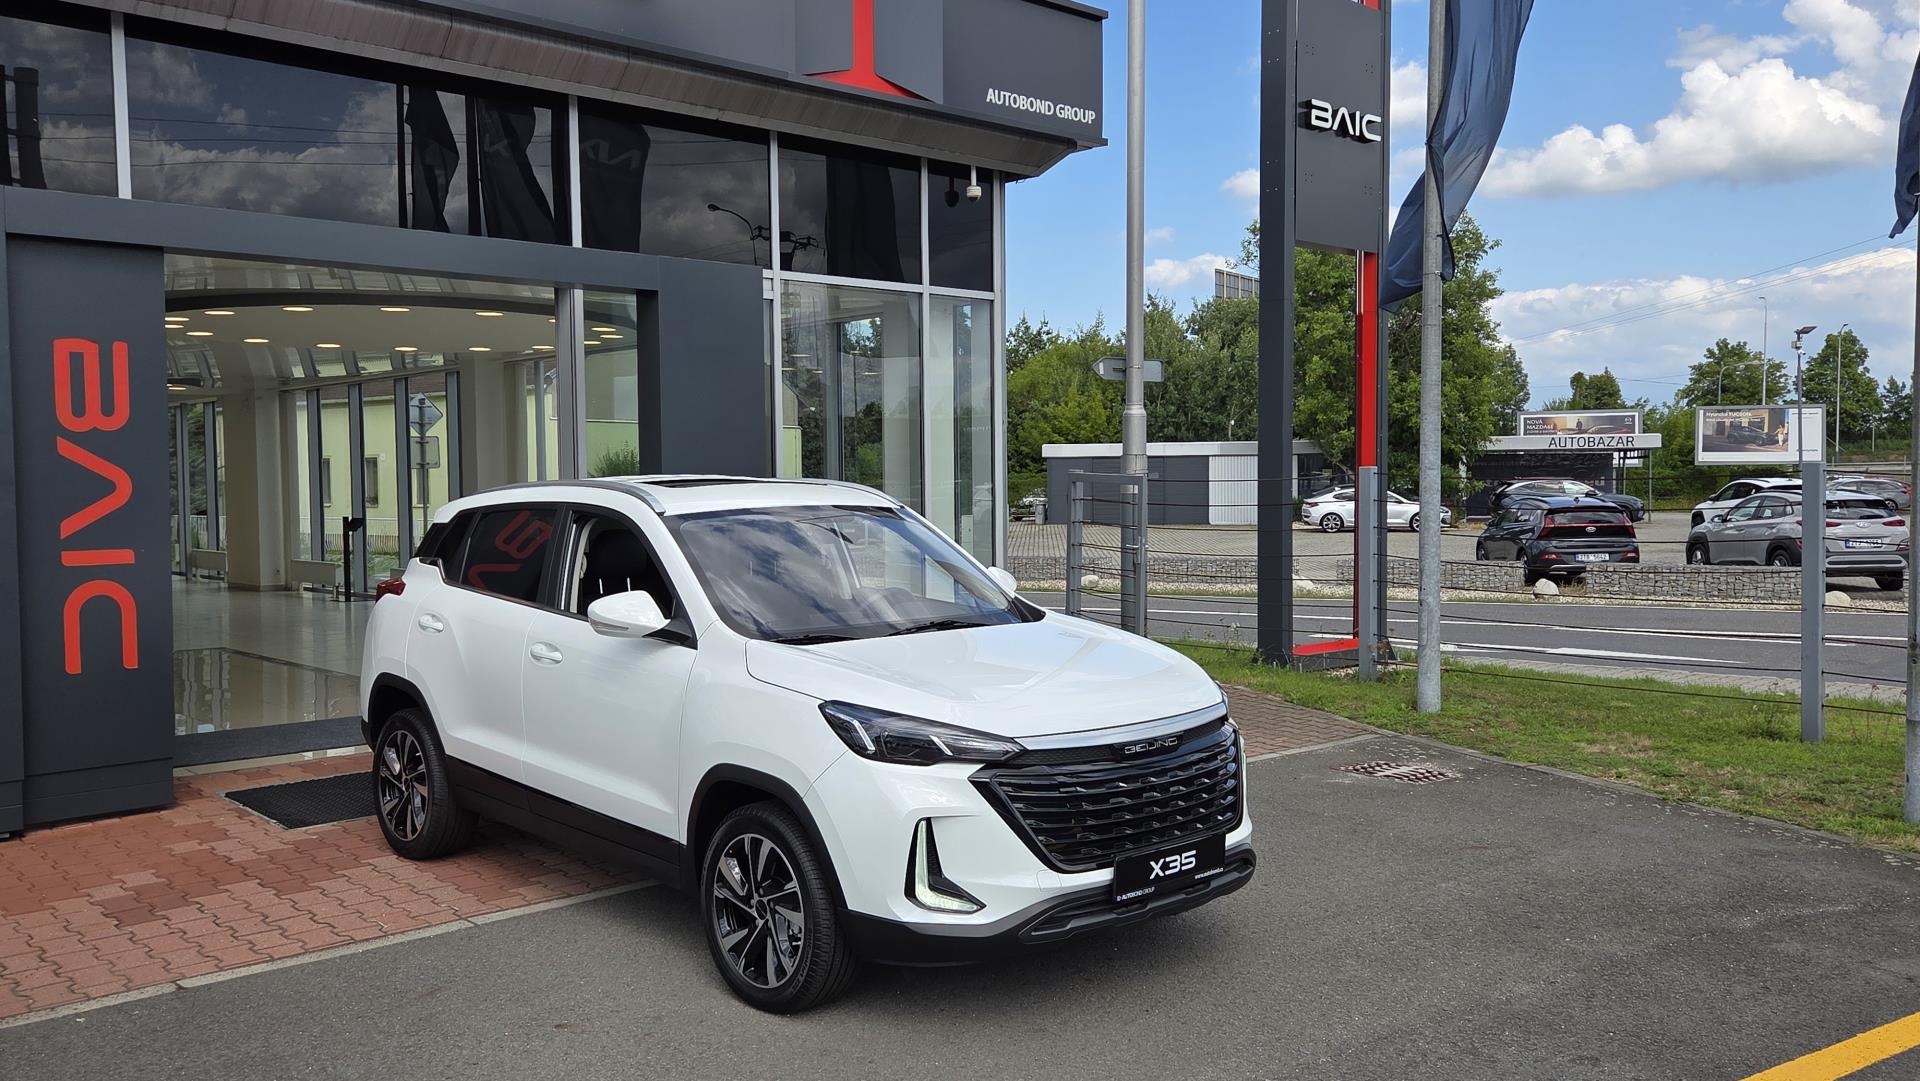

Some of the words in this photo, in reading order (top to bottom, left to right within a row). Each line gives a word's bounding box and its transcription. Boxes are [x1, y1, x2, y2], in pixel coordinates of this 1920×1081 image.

[986, 88, 1054, 115] AUTOBOND
[1056, 104, 1095, 124] GROUP
[1311, 98, 1382, 142] BAIC
[1548, 436, 1635, 448] AUTOBAZAR
[52, 337, 139, 674] BAIC
[1124, 737, 1178, 754] BEIJING
[1149, 850, 1197, 879] X35
